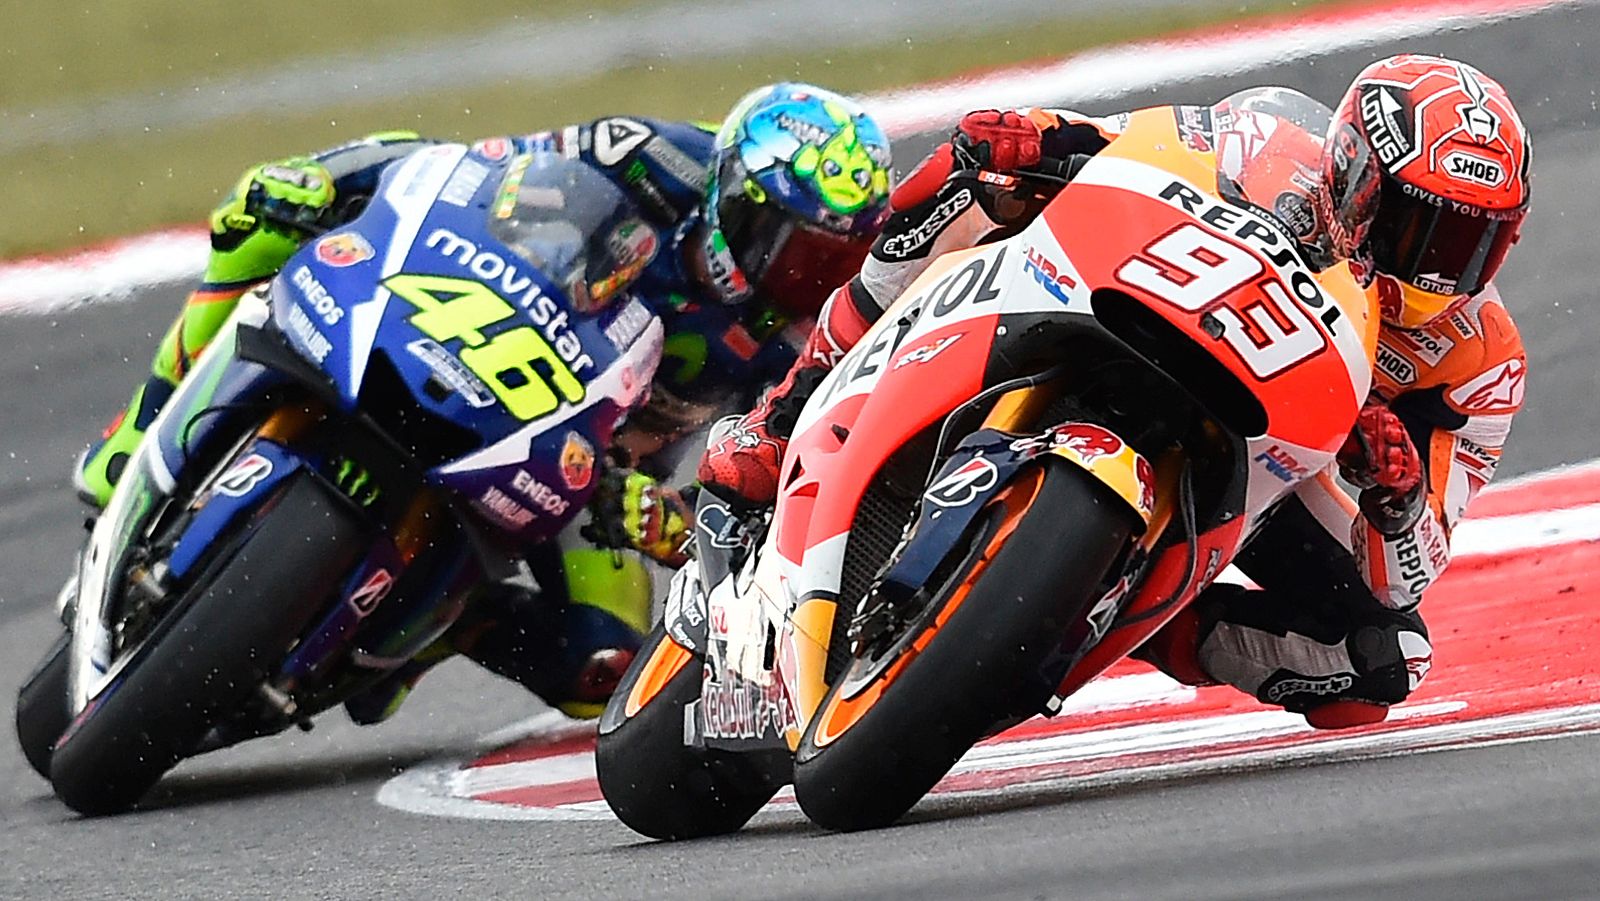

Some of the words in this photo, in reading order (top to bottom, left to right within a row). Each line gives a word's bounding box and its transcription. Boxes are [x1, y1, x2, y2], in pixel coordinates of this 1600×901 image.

[1361, 88, 1400, 164] LOTUS
[1402, 183, 1444, 207] GIVES
[1451, 201, 1481, 218] YOU
[1451, 157, 1499, 183] SHOEI
[1158, 181, 1341, 337] REPSOL
[1247, 205, 1298, 249] HONDA
[292, 264, 345, 326] ENEOS
[426, 228, 596, 373] movistar
[1113, 220, 1329, 383] 93
[1412, 276, 1455, 295] LOTUS
[380, 272, 586, 422] 46
[513, 469, 570, 517] ENEOS
[1395, 530, 1431, 600] REPSO
